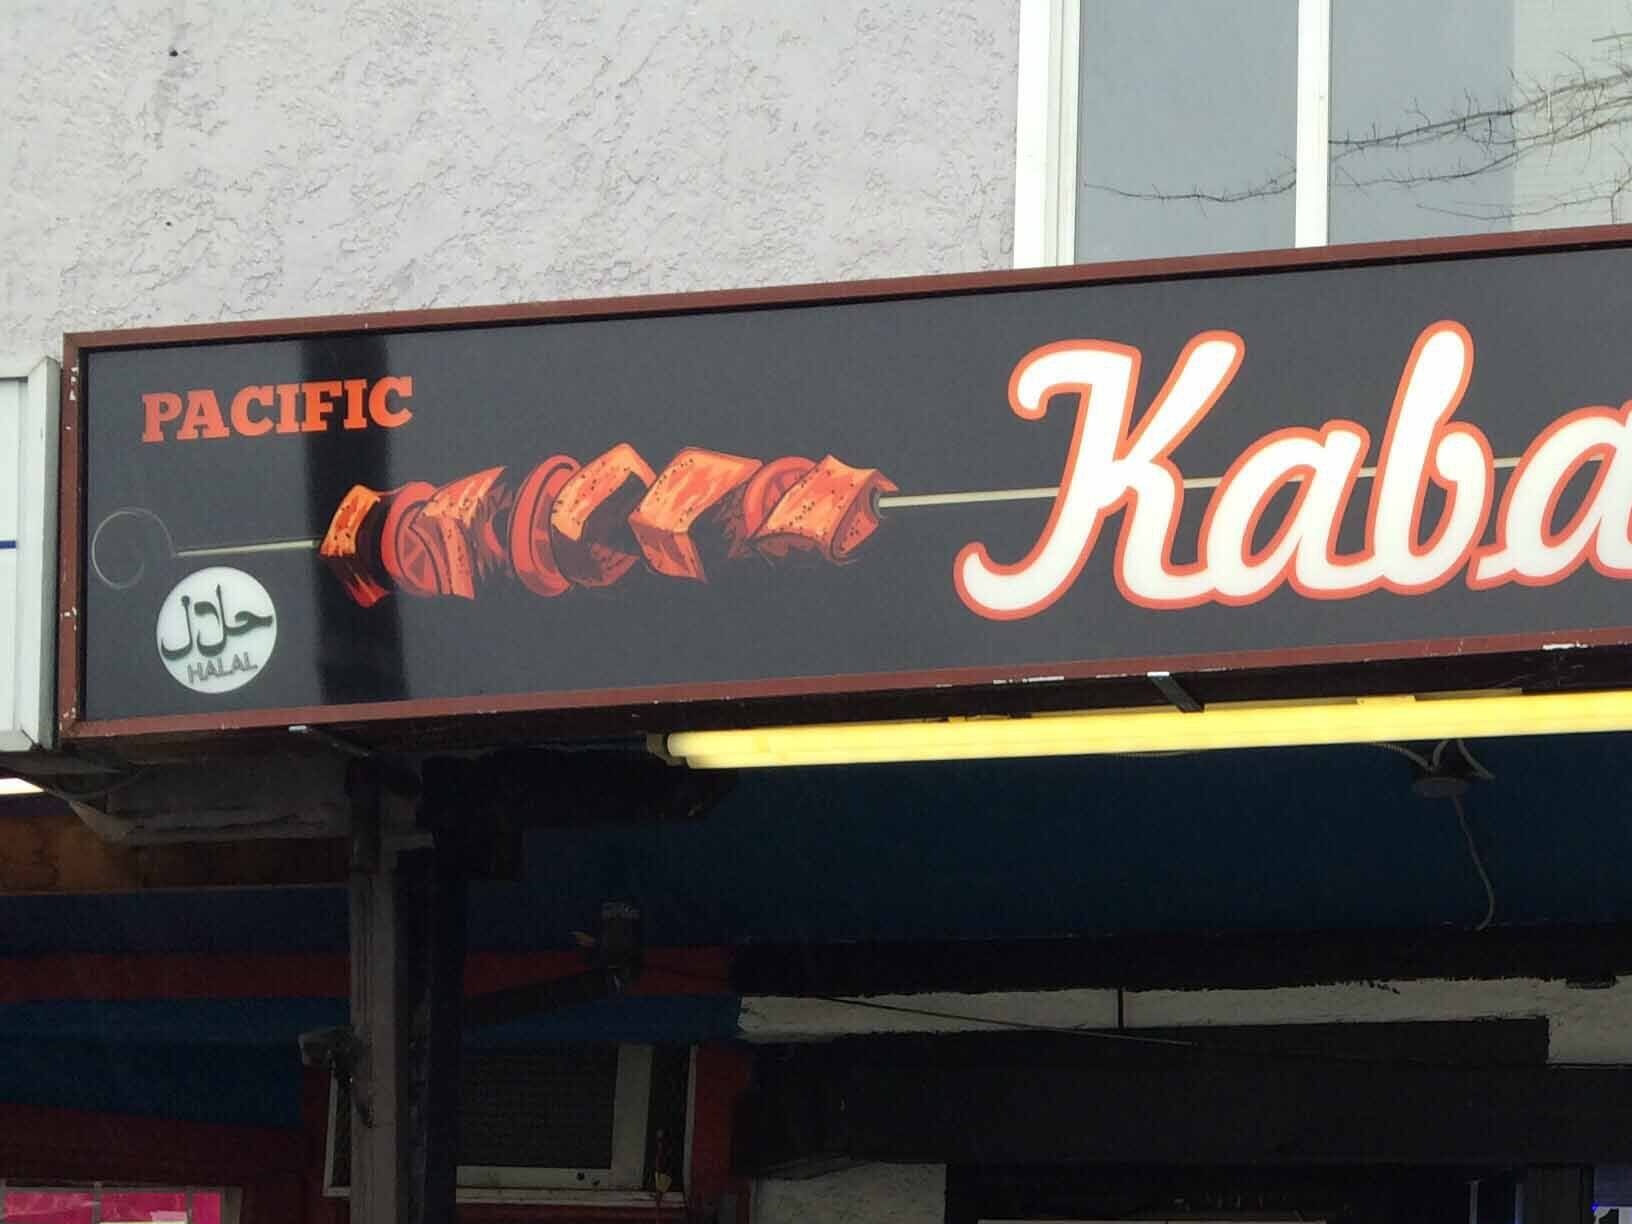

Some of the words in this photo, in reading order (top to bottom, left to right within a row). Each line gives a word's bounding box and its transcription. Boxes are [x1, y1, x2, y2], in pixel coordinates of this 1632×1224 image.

[142, 376, 413, 442] PACIFIC
[161, 584, 273, 661] حلال
[187, 651, 259, 684] HALAL
